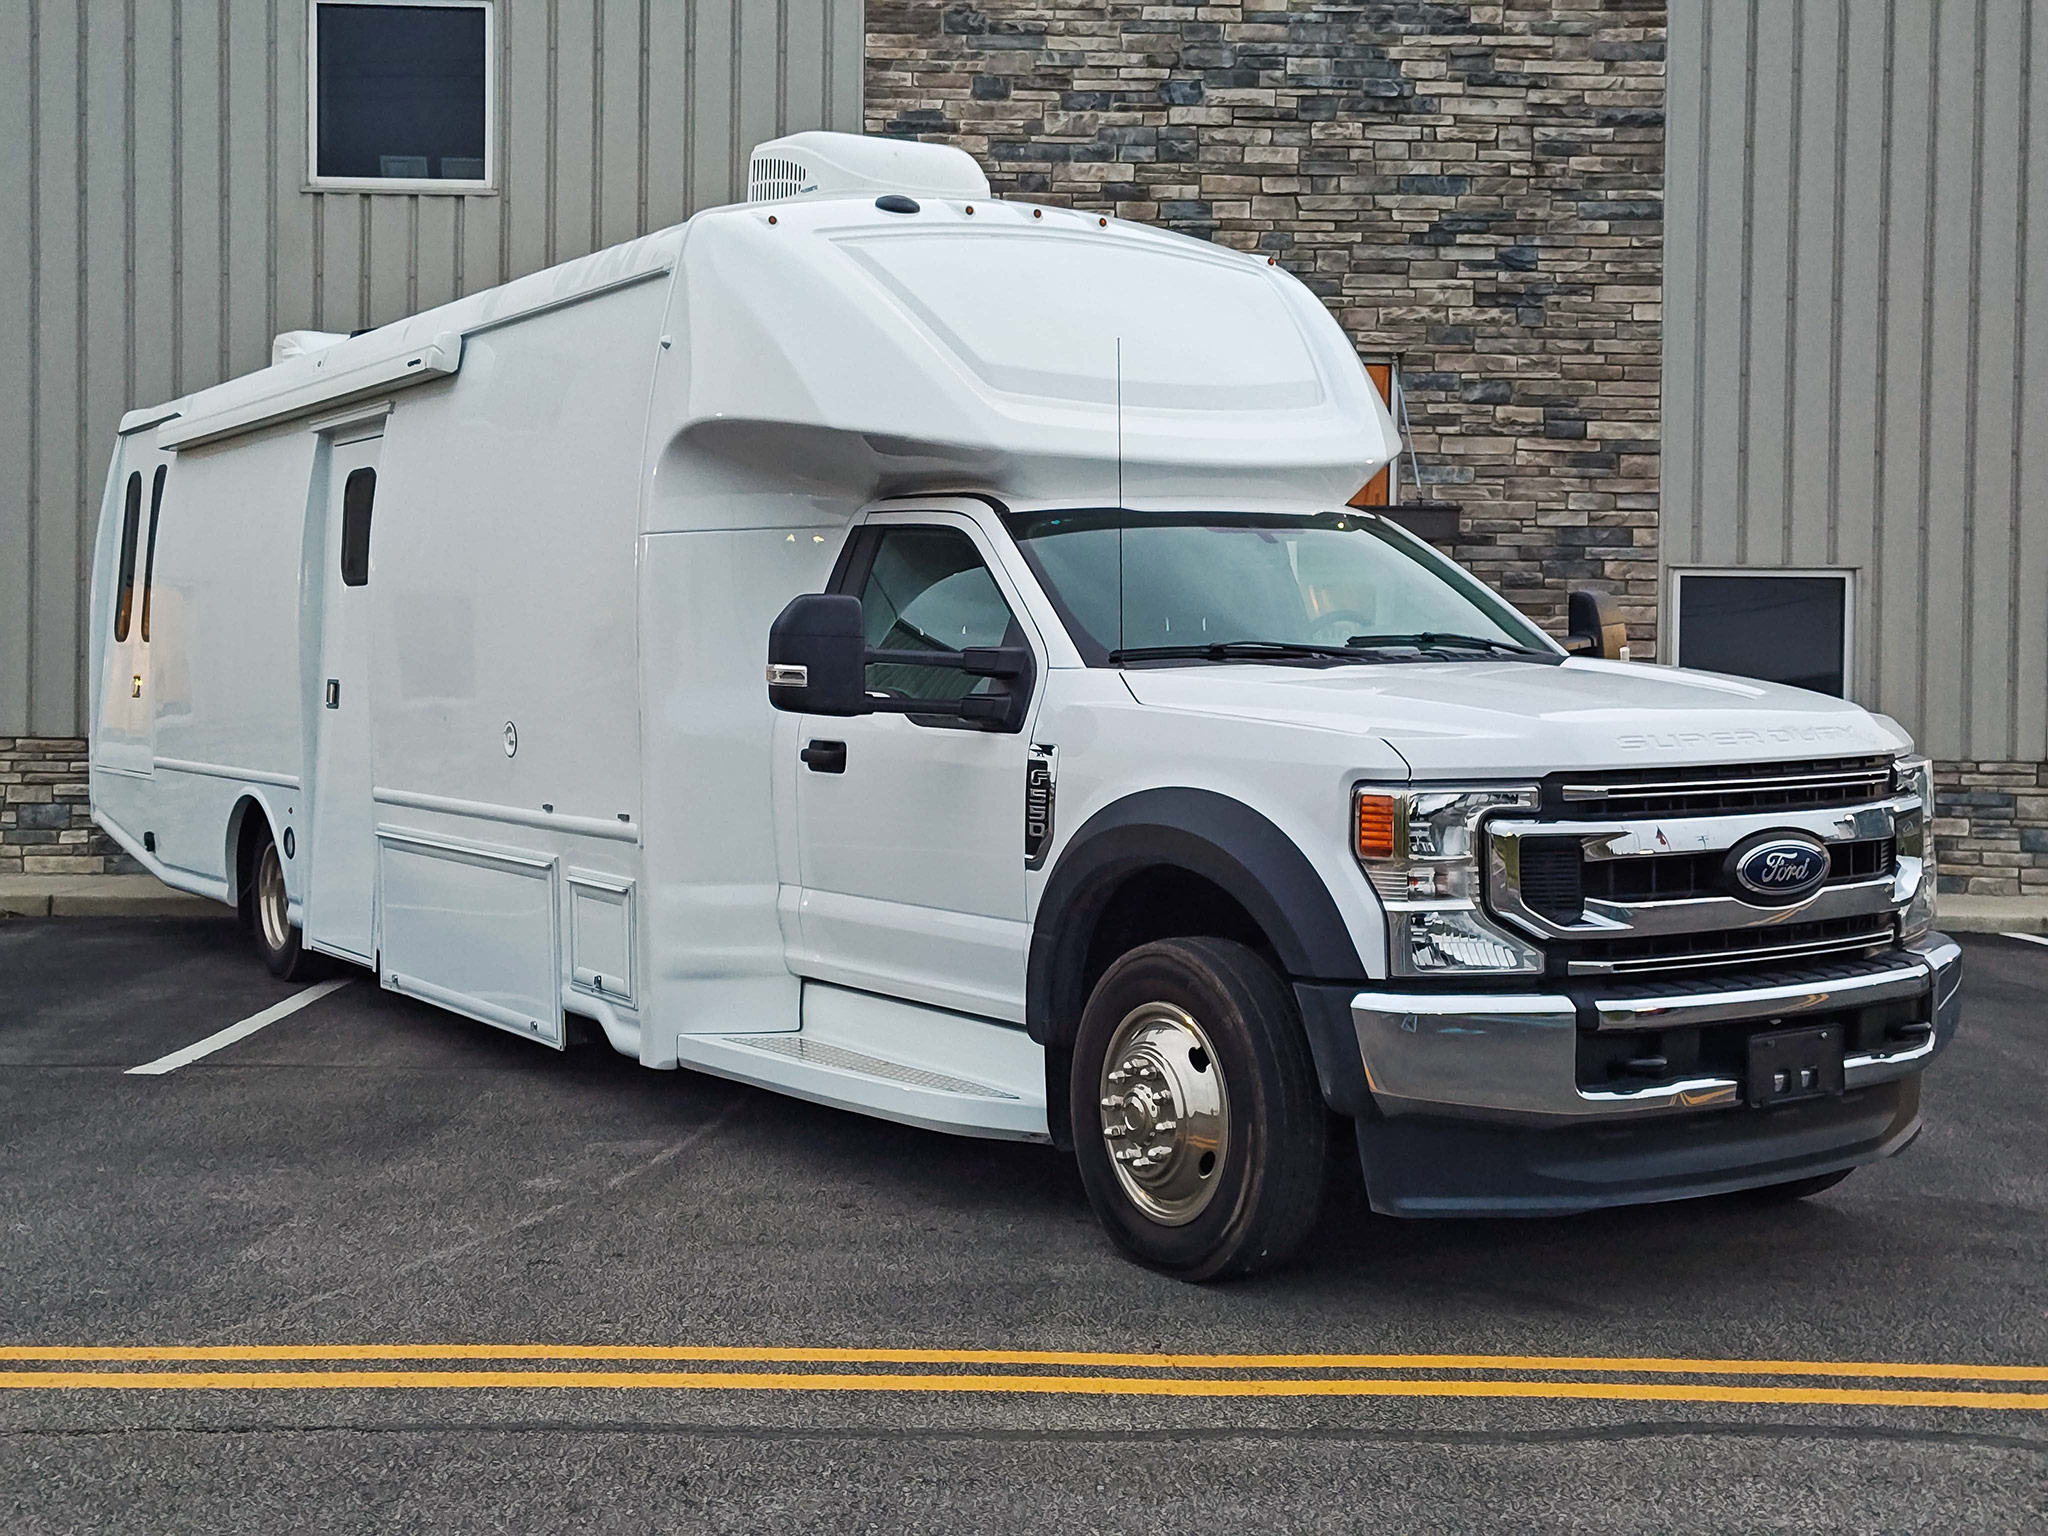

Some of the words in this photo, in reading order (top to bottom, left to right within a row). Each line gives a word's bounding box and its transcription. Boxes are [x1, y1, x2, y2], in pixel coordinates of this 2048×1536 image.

[1617, 730, 1764, 750] SUPER
[1766, 725, 1855, 744] DUTY
[1761, 852, 1811, 882] Ford
